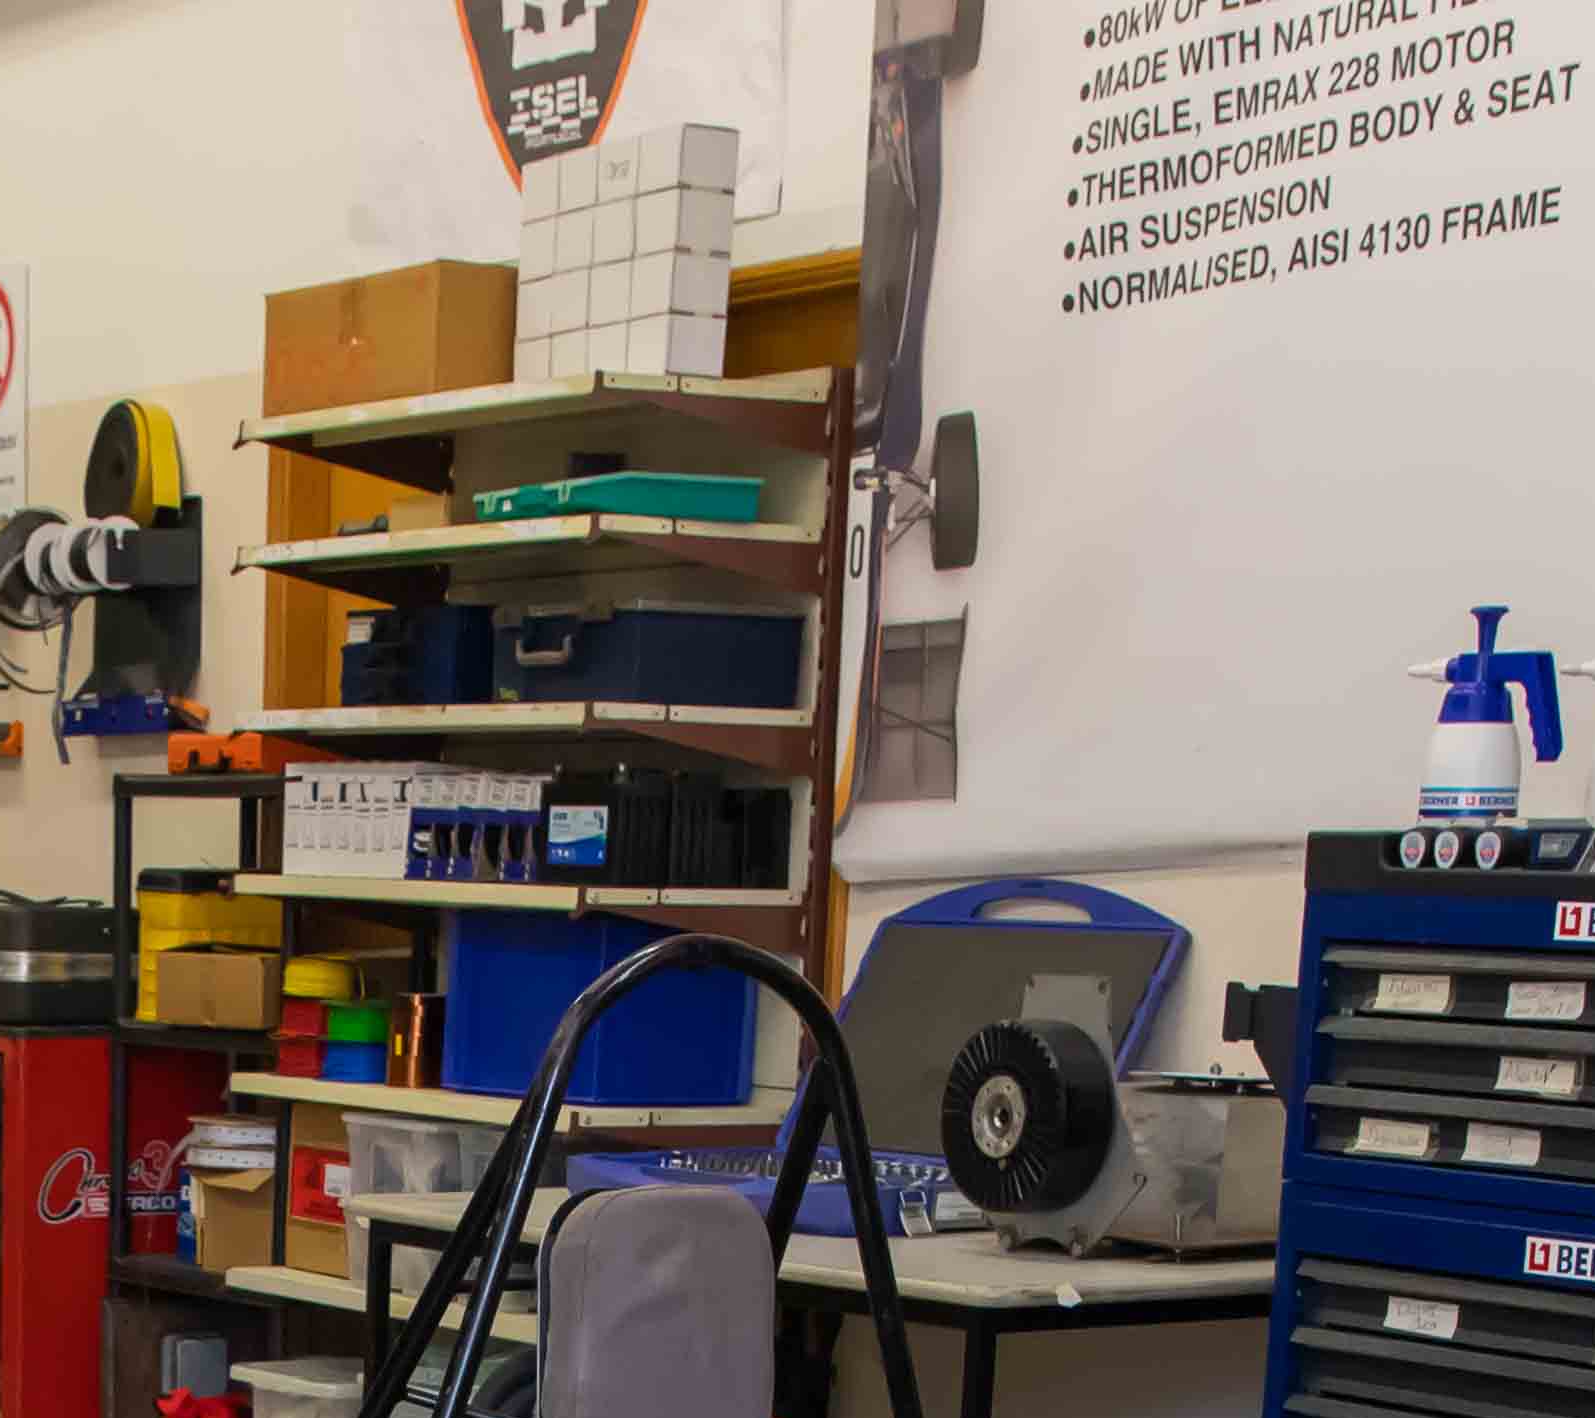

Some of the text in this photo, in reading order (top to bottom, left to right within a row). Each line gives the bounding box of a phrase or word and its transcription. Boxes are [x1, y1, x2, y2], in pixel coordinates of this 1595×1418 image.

[1094, 0, 1418, 100] MADE WITH NATURAL
[1098, 0, 1166, 48] 80kW
[1081, 62, 1582, 208] THERMOFORMED BODY & SEAT
[1084, 18, 1517, 156] SINGLE, EMRAX 228 MOTOR
[1077, 175, 1333, 264] AIR SUSPENSION
[1077, 187, 1564, 315] NORMALISED, AISI 4130 FRAME
